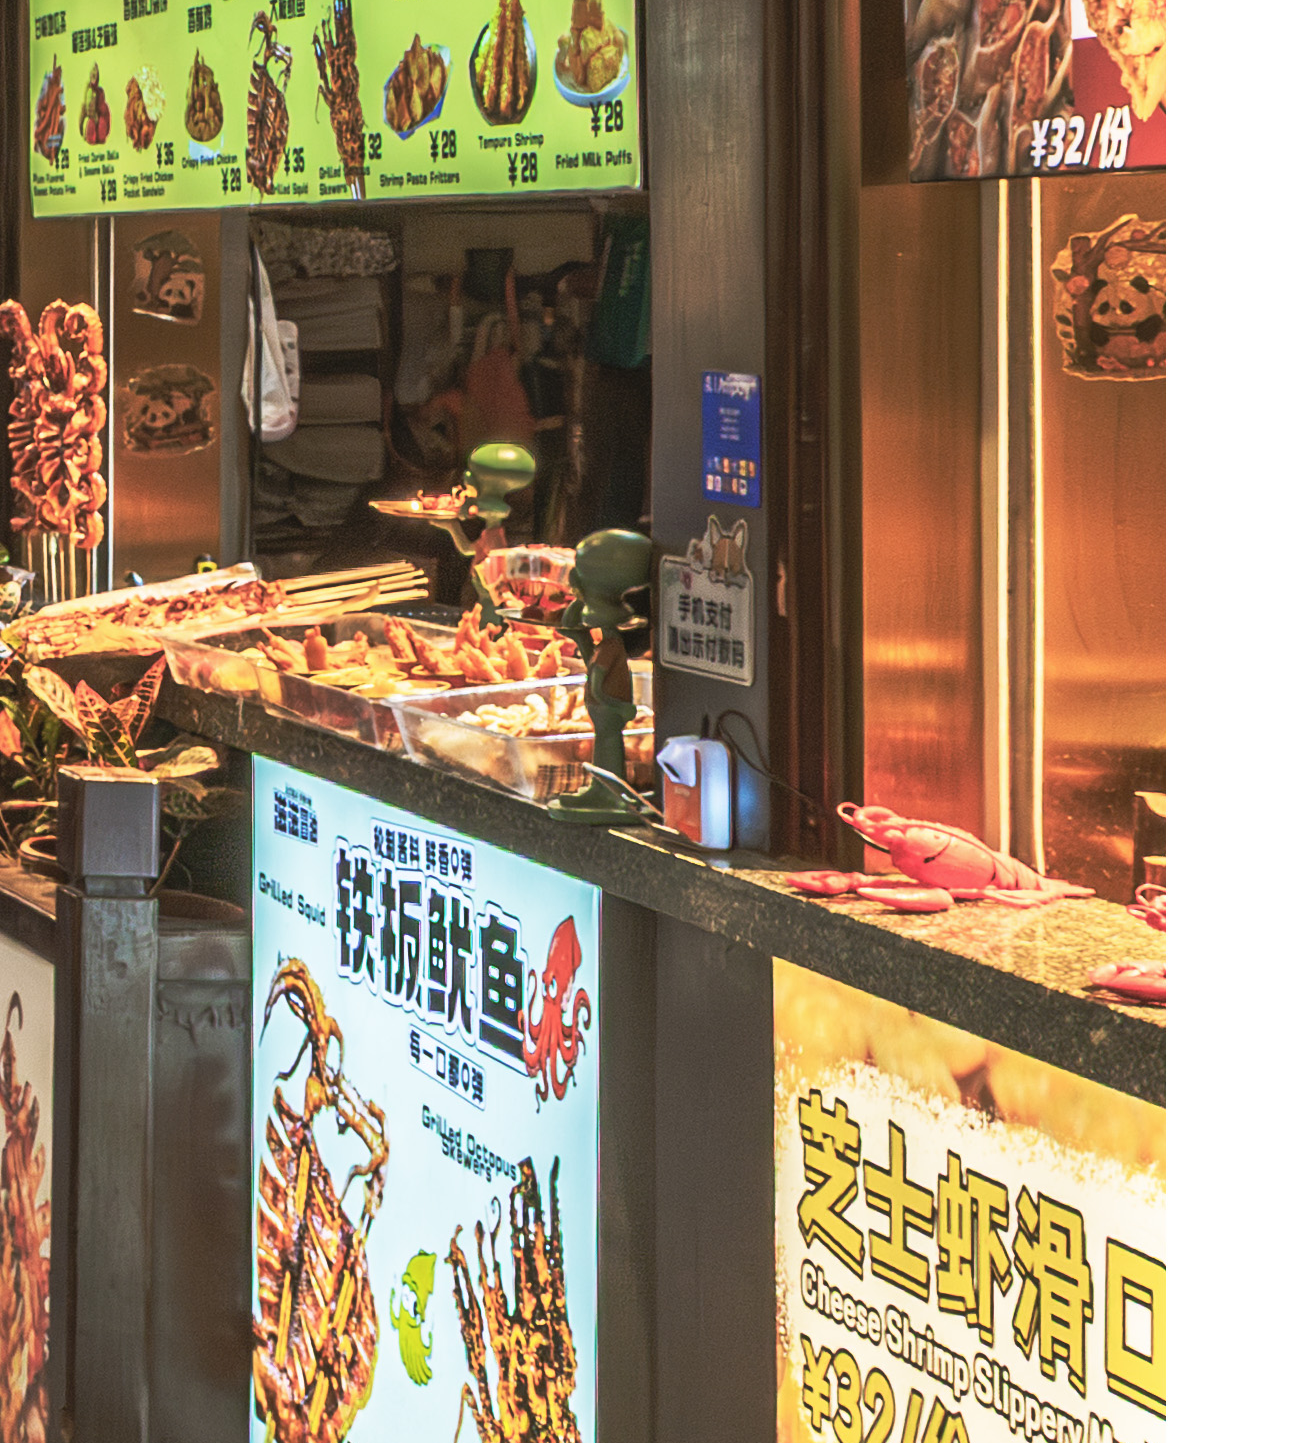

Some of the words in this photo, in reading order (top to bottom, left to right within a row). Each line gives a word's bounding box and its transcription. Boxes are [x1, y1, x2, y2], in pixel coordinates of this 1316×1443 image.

[361, 133, 383, 161] 32
[478, 134, 512, 152] Tempura
[515, 132, 544, 148] Shrimp
[556, 153, 579, 169] Fried
[582, 151, 602, 167] Milk
[606, 149, 632, 167] Puffs
[1029, 105, 1132, 170] ¥32/份
[379, 172, 405, 188] Shrimp
[406, 172, 427, 185] Paste
[428, 170, 460, 184] Fritters
[678, 593, 732, 632] 手机支付
[258, 871, 293, 910] Grilled
[297, 893, 326, 927] Squid
[335, 846, 526, 1064] 铁板鱿鱼
[422, 1104, 462, 1147] Grilled
[466, 1133, 517, 1178] Octopus
[441, 1134, 493, 1183] Skewers
[798, 1088, 1165, 1419] 芝士虾滑口
[800, 1258, 882, 1345] Cheese
[883, 1304, 970, 1402] Shrimp
